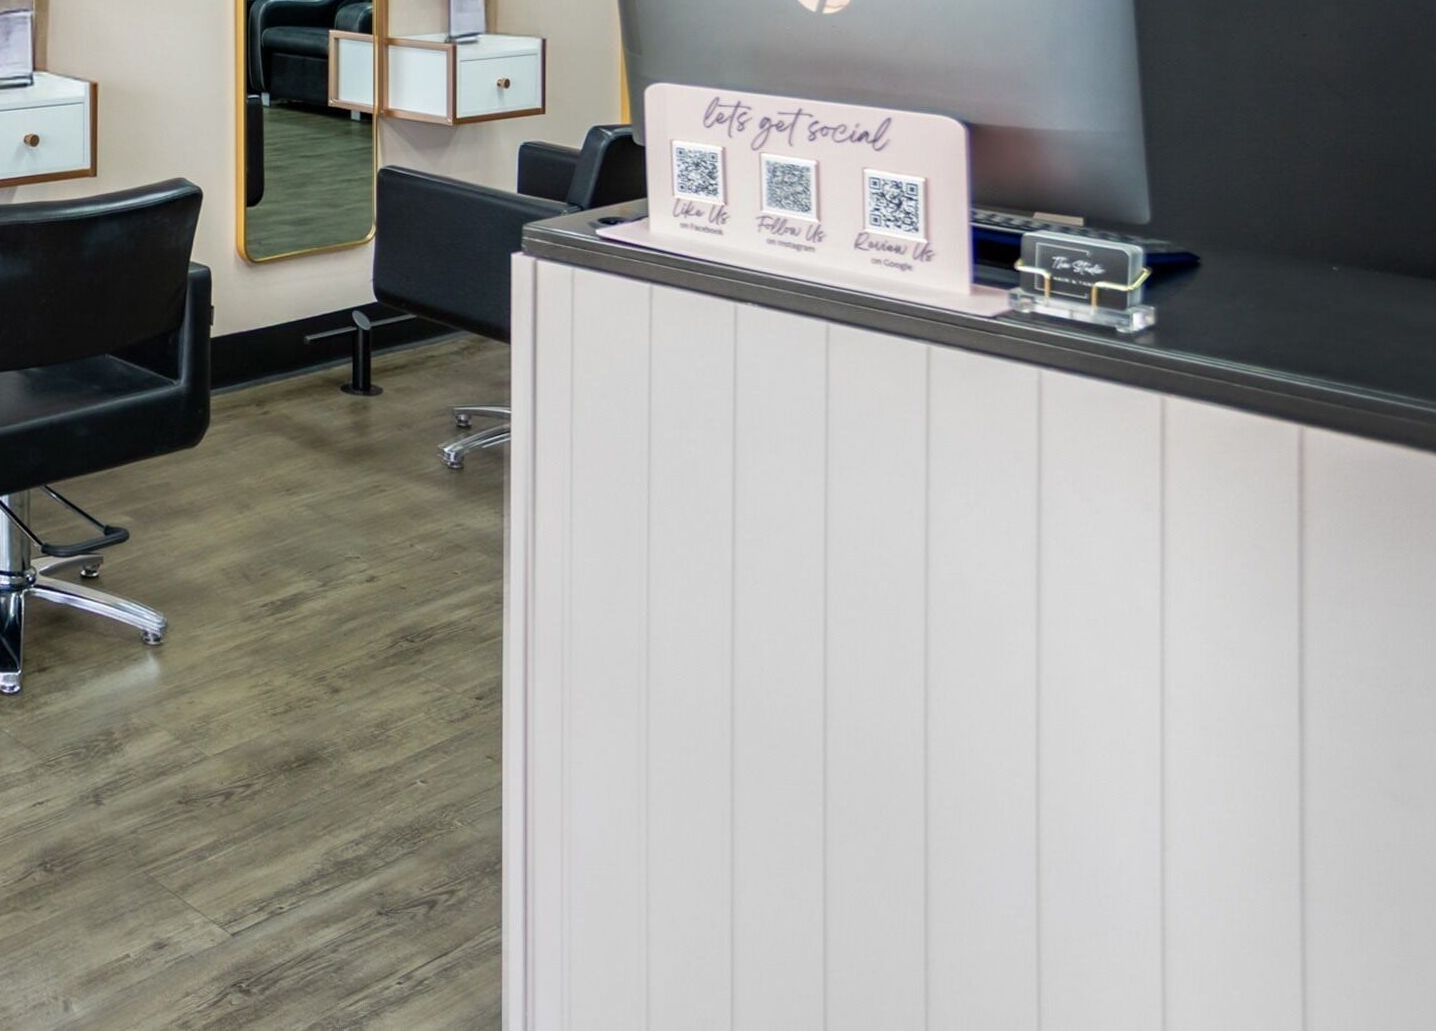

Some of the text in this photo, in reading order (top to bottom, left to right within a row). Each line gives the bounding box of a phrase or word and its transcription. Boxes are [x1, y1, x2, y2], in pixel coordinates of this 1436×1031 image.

[751, 108, 813, 151] get
[807, 117, 892, 152] social
[672, 198, 731, 226] Like Us
[756, 215, 827, 244] Follow Us
[854, 232, 936, 262] Review Us
